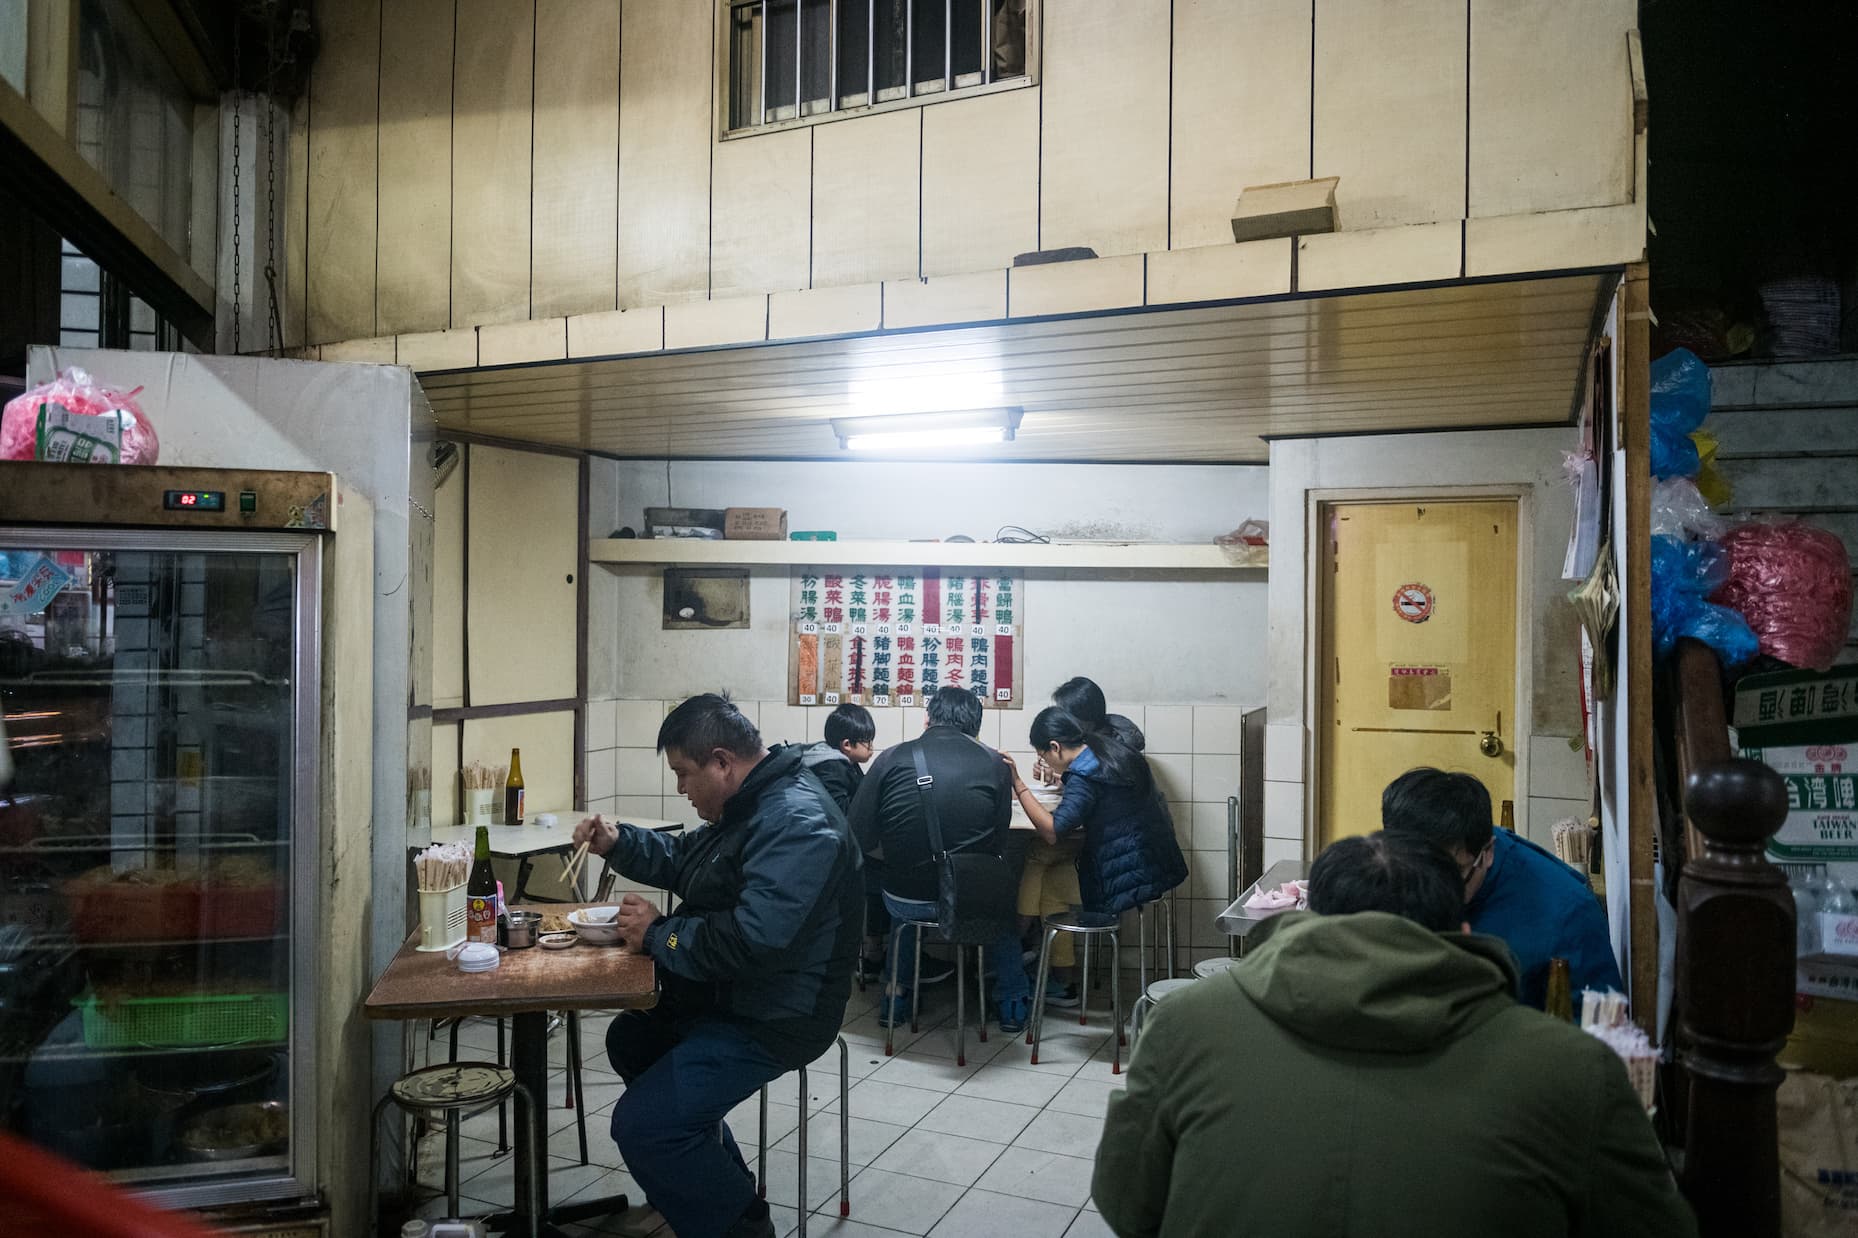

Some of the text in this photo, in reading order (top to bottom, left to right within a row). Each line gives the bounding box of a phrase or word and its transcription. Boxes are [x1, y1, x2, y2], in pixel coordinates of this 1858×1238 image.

[800, 574, 819, 622] 粉腸湯
[824, 574, 844, 623] 酸菜鴨
[849, 574, 867, 622] 冬菜鴨
[872, 575, 893, 622] 脆腸湯
[897, 575, 916, 623] 鴨血湯
[995, 575, 1014, 624] 當歸鴨
[804, 624, 815, 632] 40
[826, 624, 837, 632] 40
[854, 626, 865, 634] 40
[878, 626, 889, 634] 40
[898, 624, 909, 632] 40
[950, 625, 961, 633] 40
[973, 626, 983, 635] 40
[998, 625, 1009, 634] 40
[945, 638, 964, 688] 鴨肉冬
[826, 695, 837, 703] 40
[998, 690, 1008, 699] 40
[901, 696, 912, 704] 40
[1813, 819, 1857, 830] TAIWAN
[1819, 830, 1854, 840] BEER
